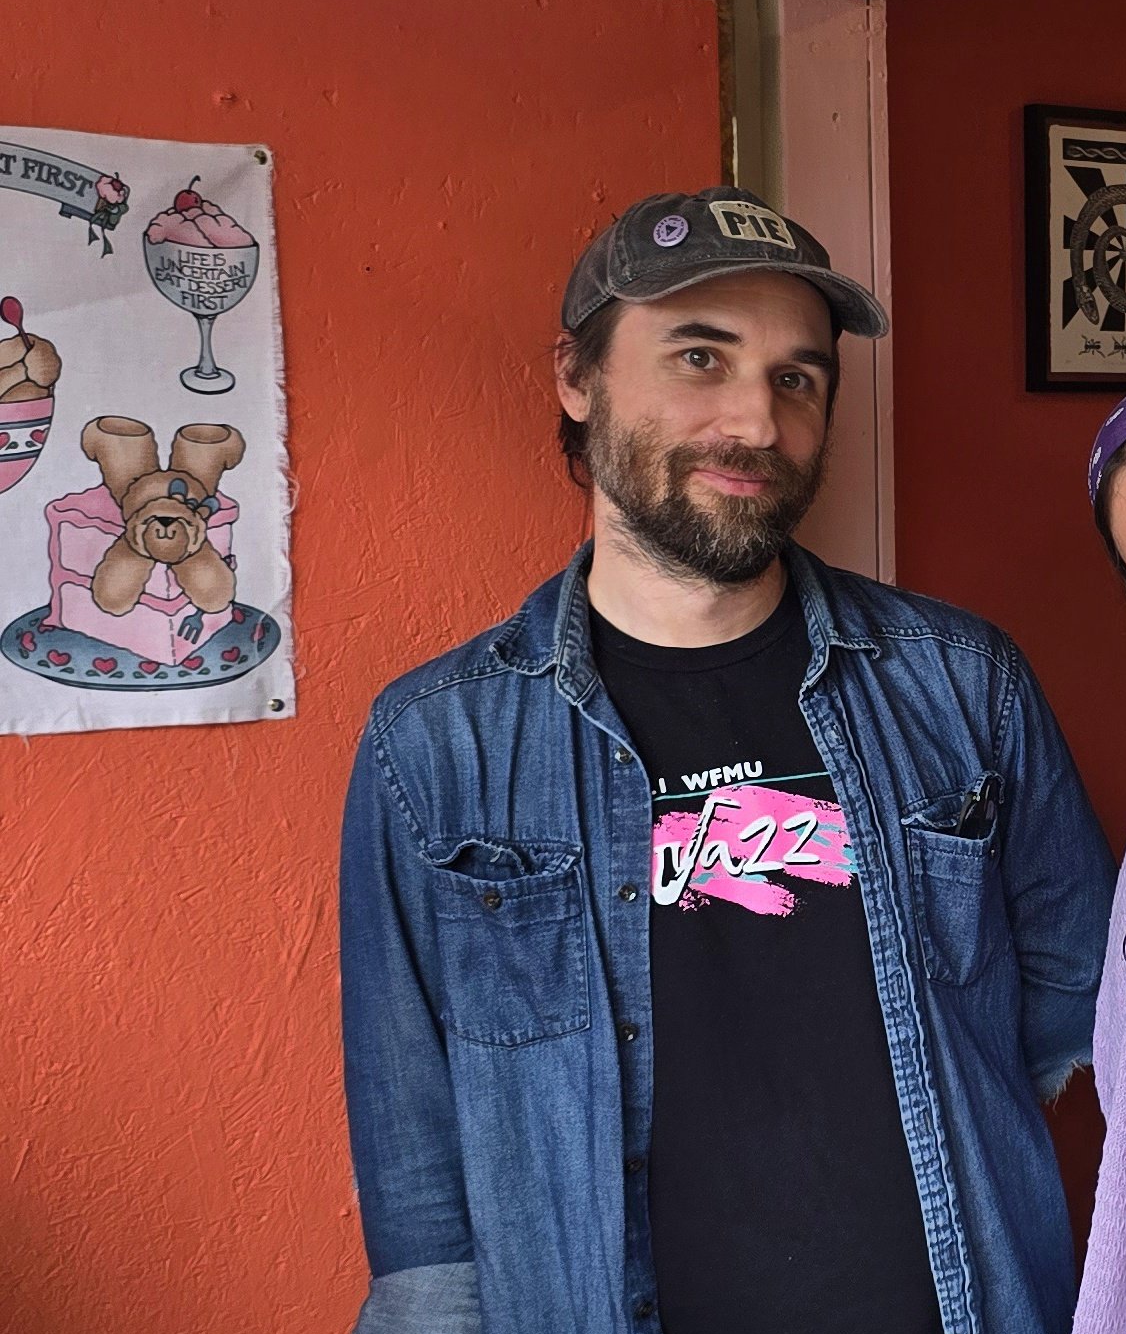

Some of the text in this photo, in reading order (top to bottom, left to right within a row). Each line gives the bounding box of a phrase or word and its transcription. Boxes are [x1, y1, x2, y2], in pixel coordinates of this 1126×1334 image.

[0, 153, 94, 198] T FIRST
[721, 210, 789, 244] PIE
[161, 255, 245, 281] UNCERTAIN
[178, 249, 227, 267] LIFE IS
[155, 267, 251, 295] EAT DESSERT
[180, 291, 228, 310] FIRST
[681, 760, 763, 791] WFMU
